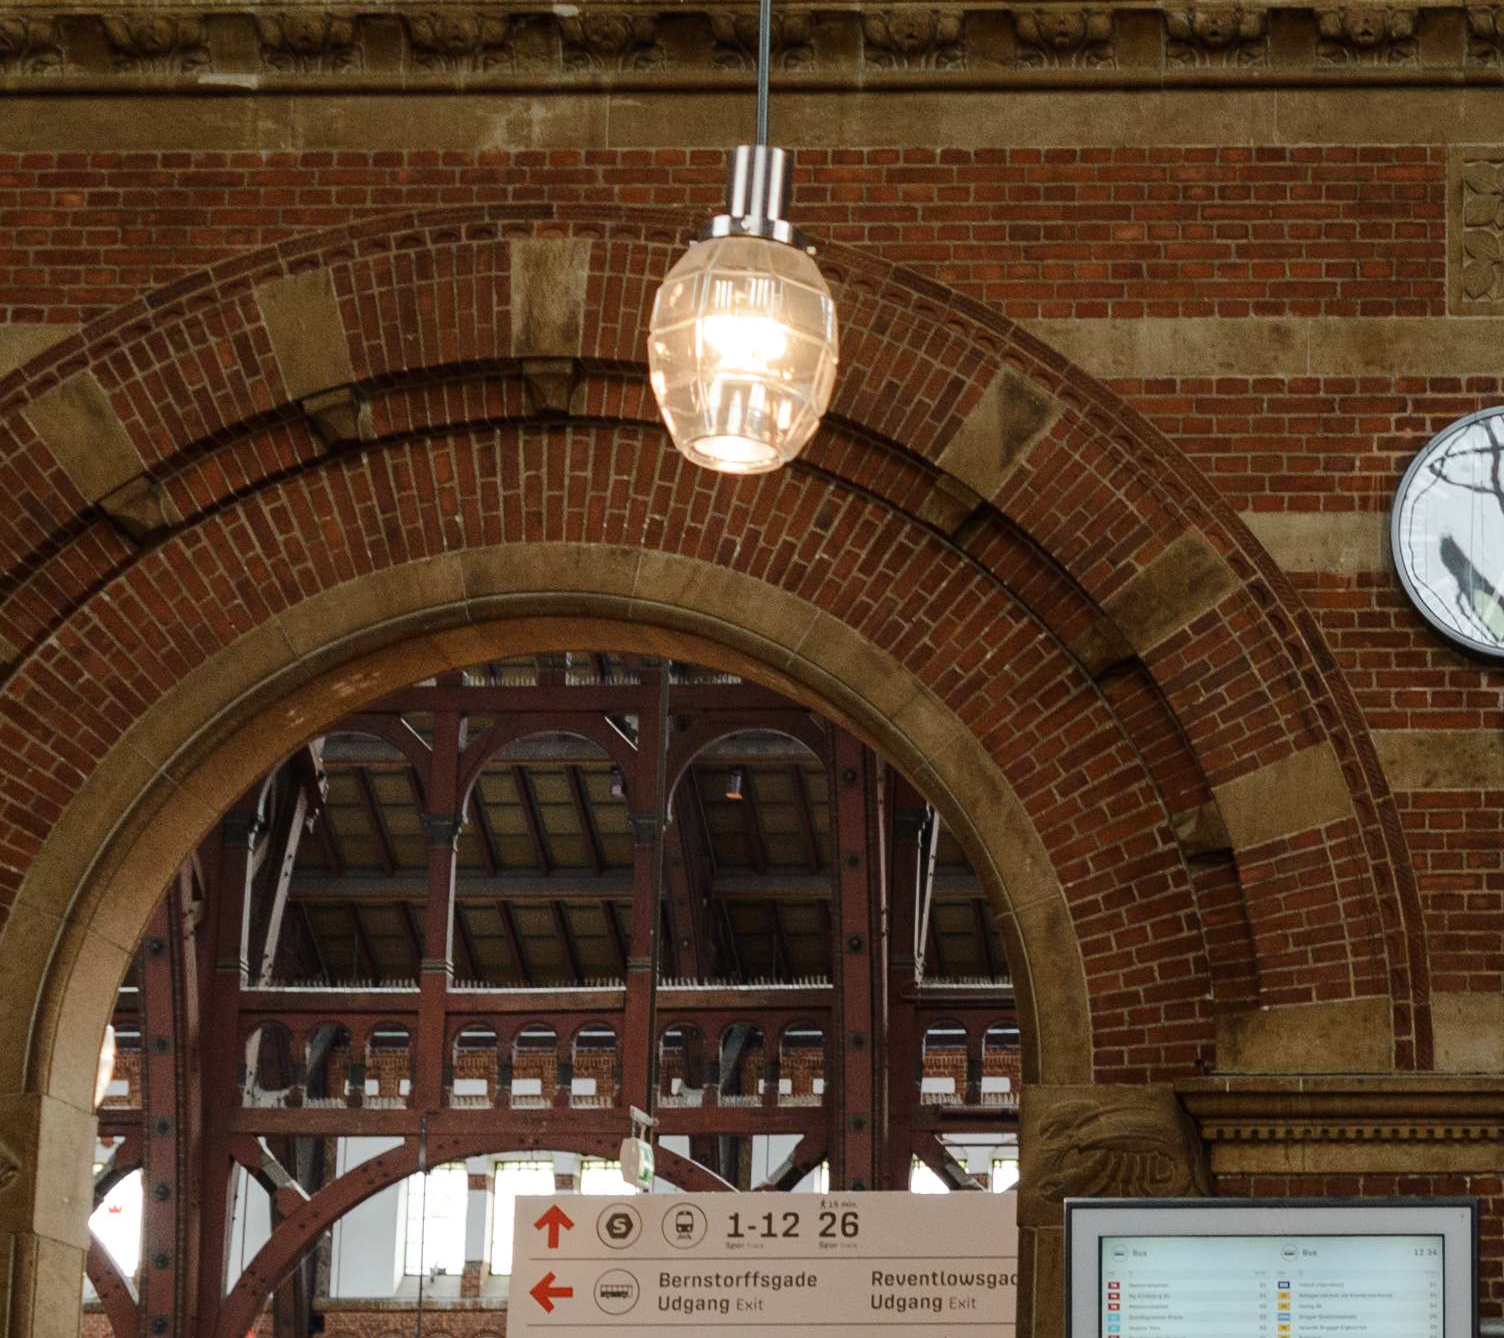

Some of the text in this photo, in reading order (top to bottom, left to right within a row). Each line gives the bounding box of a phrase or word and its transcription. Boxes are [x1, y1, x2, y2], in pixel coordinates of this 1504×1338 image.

[727, 1211, 859, 1238] 1-12 26
[726, 1241, 744, 1249] Spor
[819, 1241, 837, 1249] Spor
[1132, 1249, 1148, 1257] Bus
[1302, 1249, 1318, 1257] Bus
[659, 1271, 818, 1291] Bernstorffsgade
[658, 1295, 764, 1314] Udgang Exit
[871, 1294, 976, 1312] Udgang Exit
